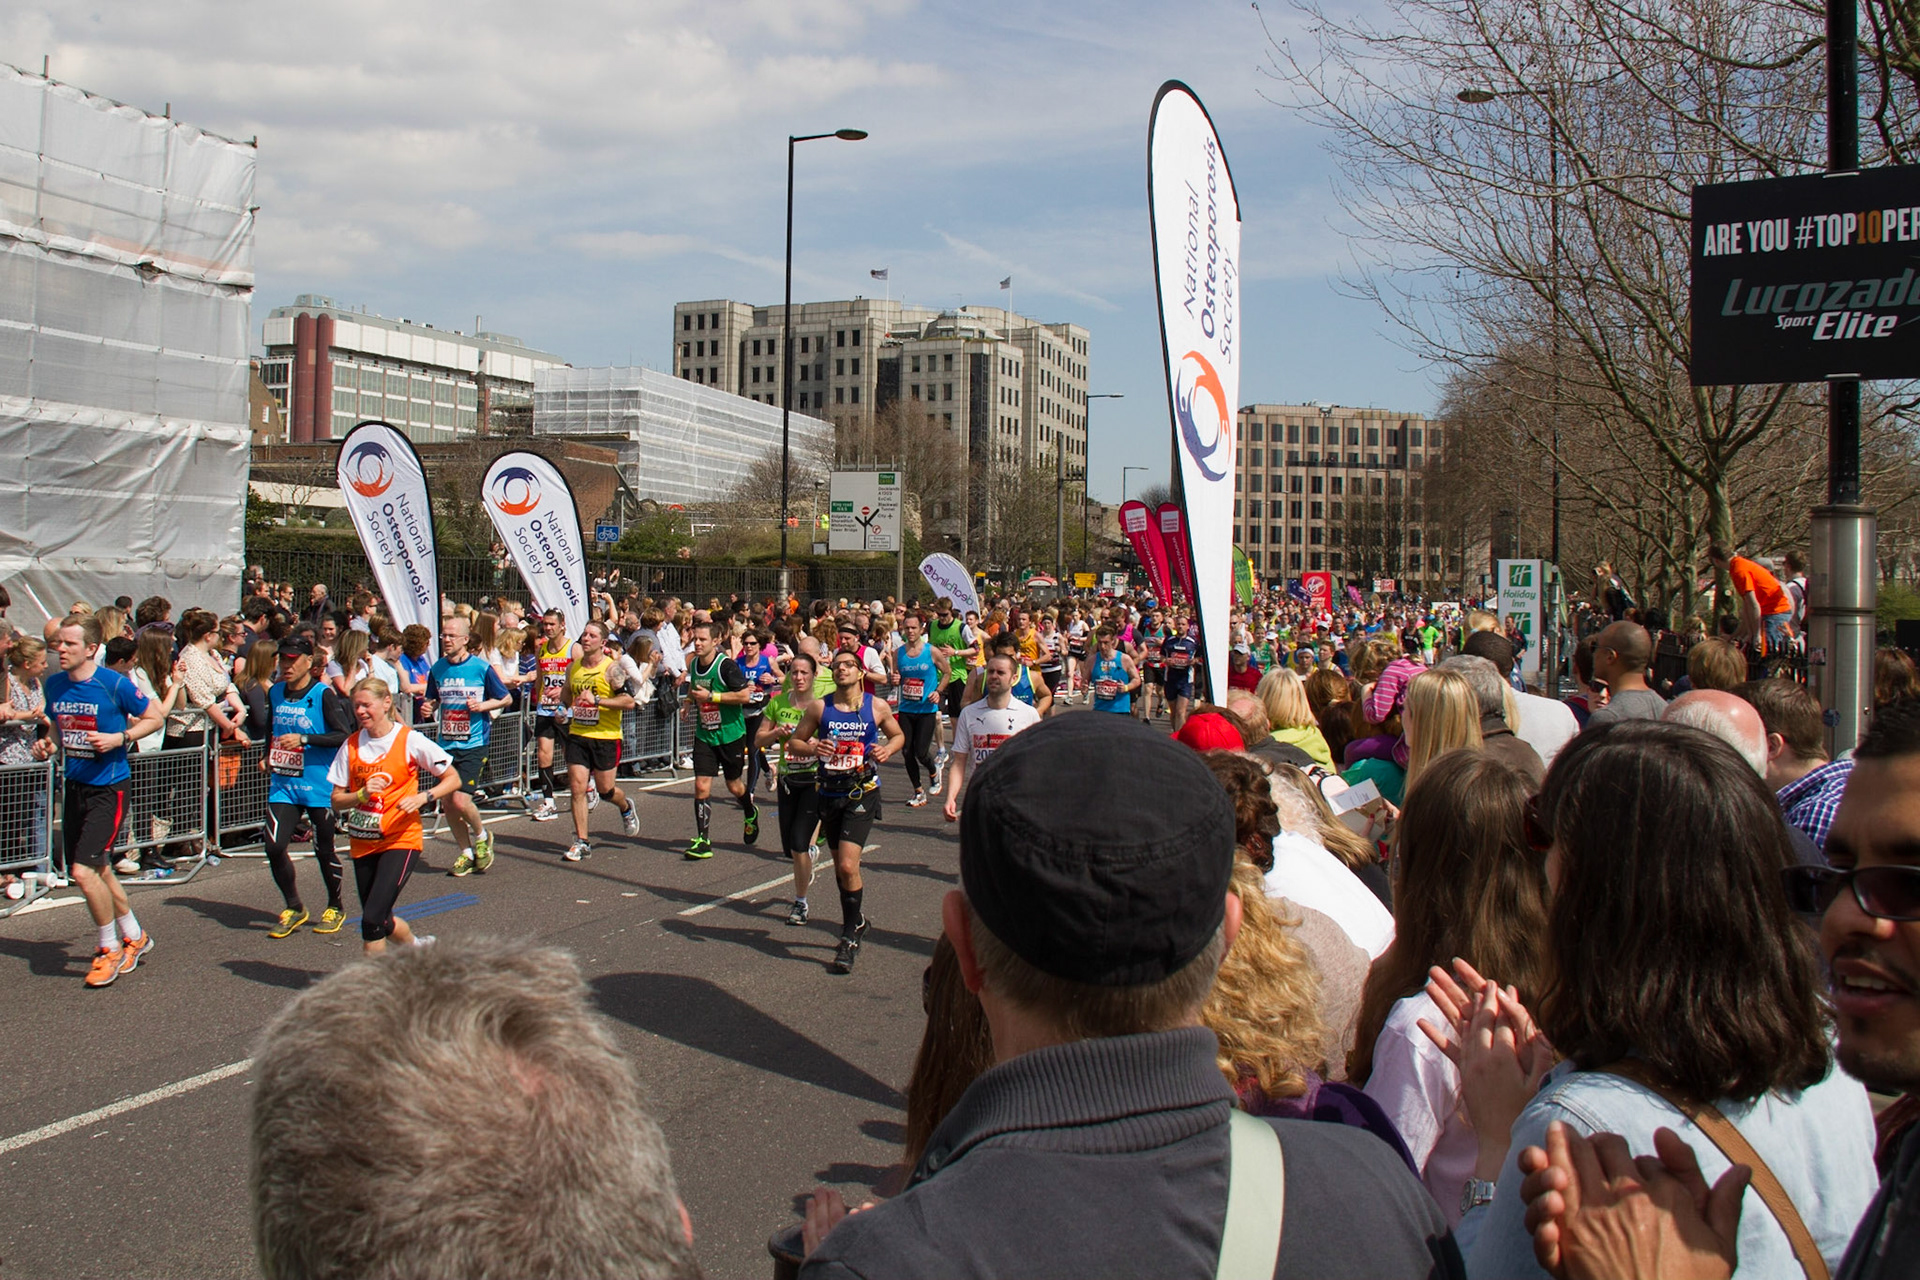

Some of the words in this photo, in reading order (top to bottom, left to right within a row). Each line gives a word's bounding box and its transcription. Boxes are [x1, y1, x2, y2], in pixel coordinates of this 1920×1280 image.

[1183, 179, 1199, 320] National
[1201, 136, 1220, 339] Osteoporosis
[1703, 223, 1743, 257] ARE
[1747, 218, 1790, 254] YOU
[1219, 247, 1237, 364] Society
[1775, 314, 1816, 330] Sport
[1812, 310, 1898, 341] Elite
[366, 510, 396, 567] Society
[395, 492, 432, 559] National
[543, 510, 582, 567] National
[382, 502, 430, 606] Osteoporosis
[513, 526, 545, 575] Society
[530, 519, 580, 607] Osteoporosis
[1503, 588, 1537, 600] Holiday
[1511, 599, 1526, 608] Inn
[443, 677, 466, 687] SAM
[52, 701, 99, 715] KARSTEN
[275, 705, 306, 716] LOTHAIR
[828, 721, 869, 731] ROOSHY
[271, 751, 304, 767] 48768
